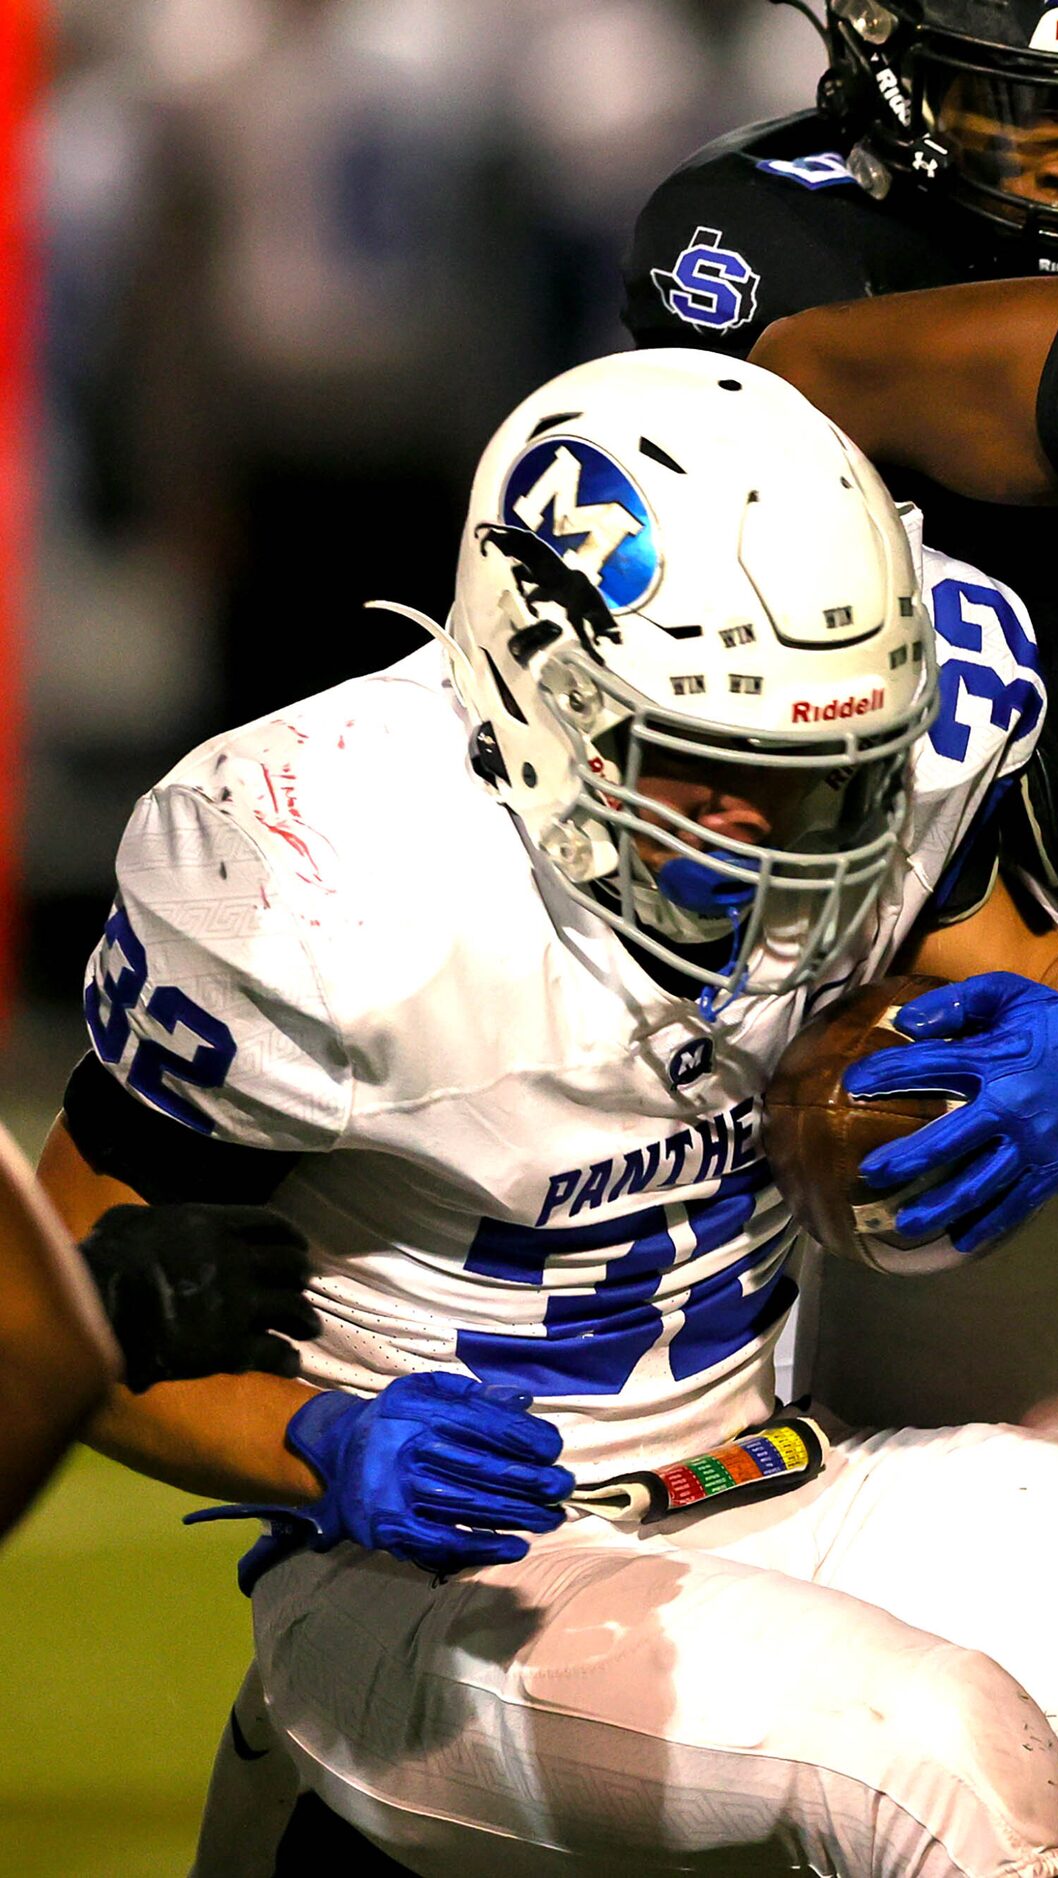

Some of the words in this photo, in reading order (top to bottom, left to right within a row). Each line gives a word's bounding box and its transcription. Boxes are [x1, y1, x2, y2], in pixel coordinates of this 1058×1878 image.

[669, 244, 751, 329] S
[512, 445, 646, 587] M
[792, 688, 884, 723] Riddell
[927, 578, 1044, 763] 32
[84, 906, 237, 1136] 32
[535, 1094, 767, 1228] PANTHE
